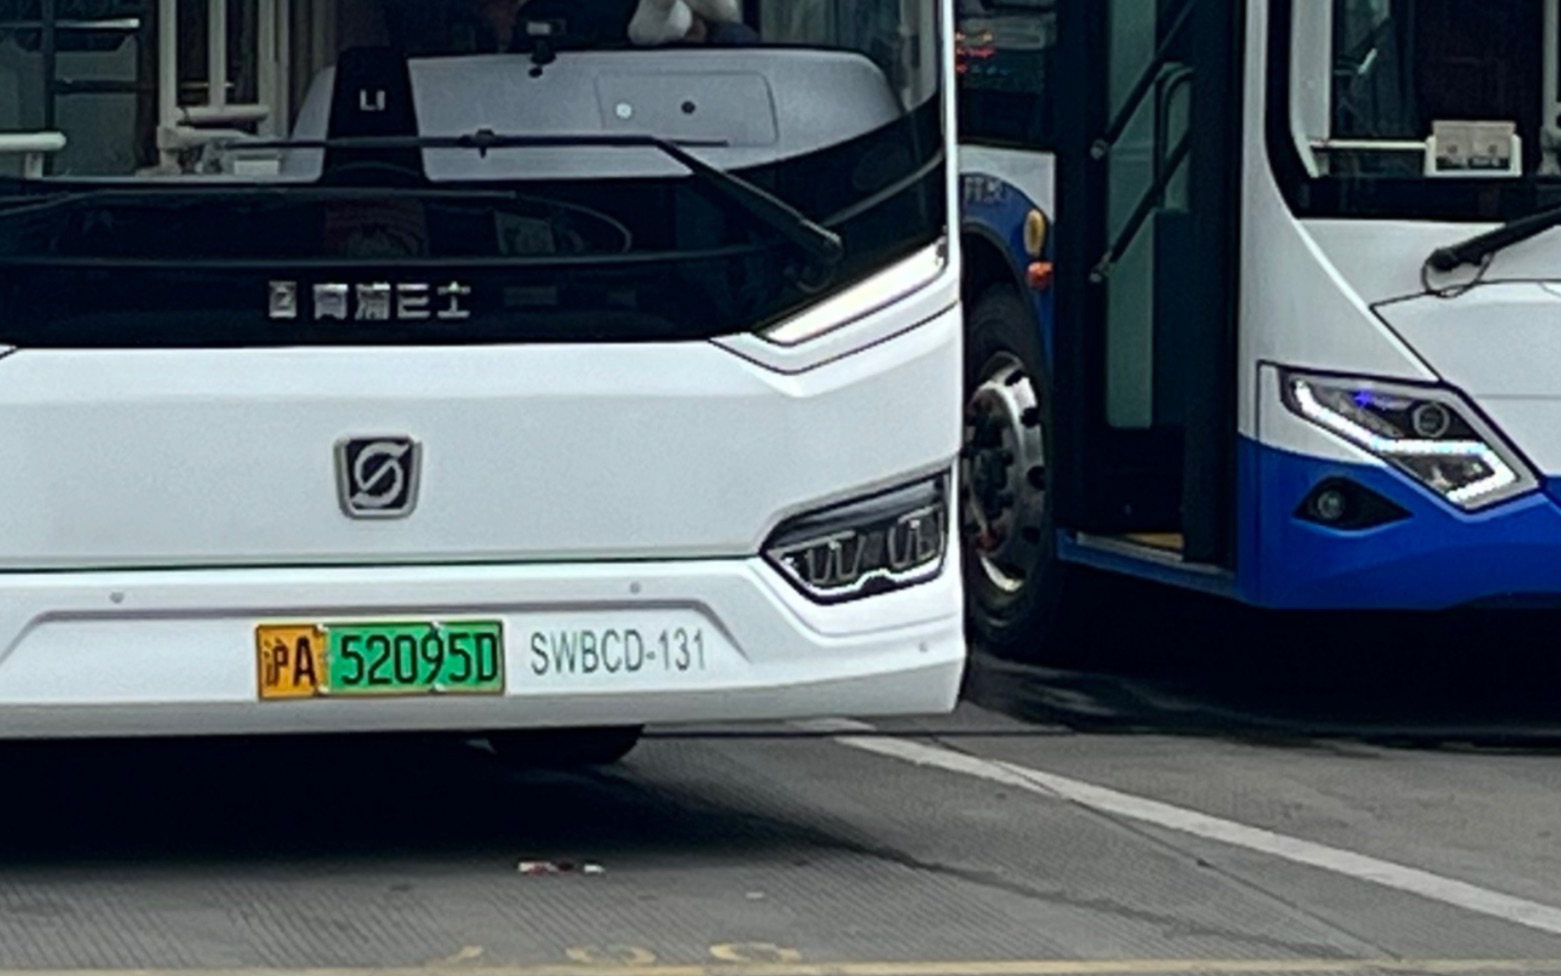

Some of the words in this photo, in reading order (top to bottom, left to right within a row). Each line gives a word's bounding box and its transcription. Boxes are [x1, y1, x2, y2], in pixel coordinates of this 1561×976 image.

[313, 281, 471, 320] 青浦巴士
[530, 627, 706, 676] SWBCD-131
